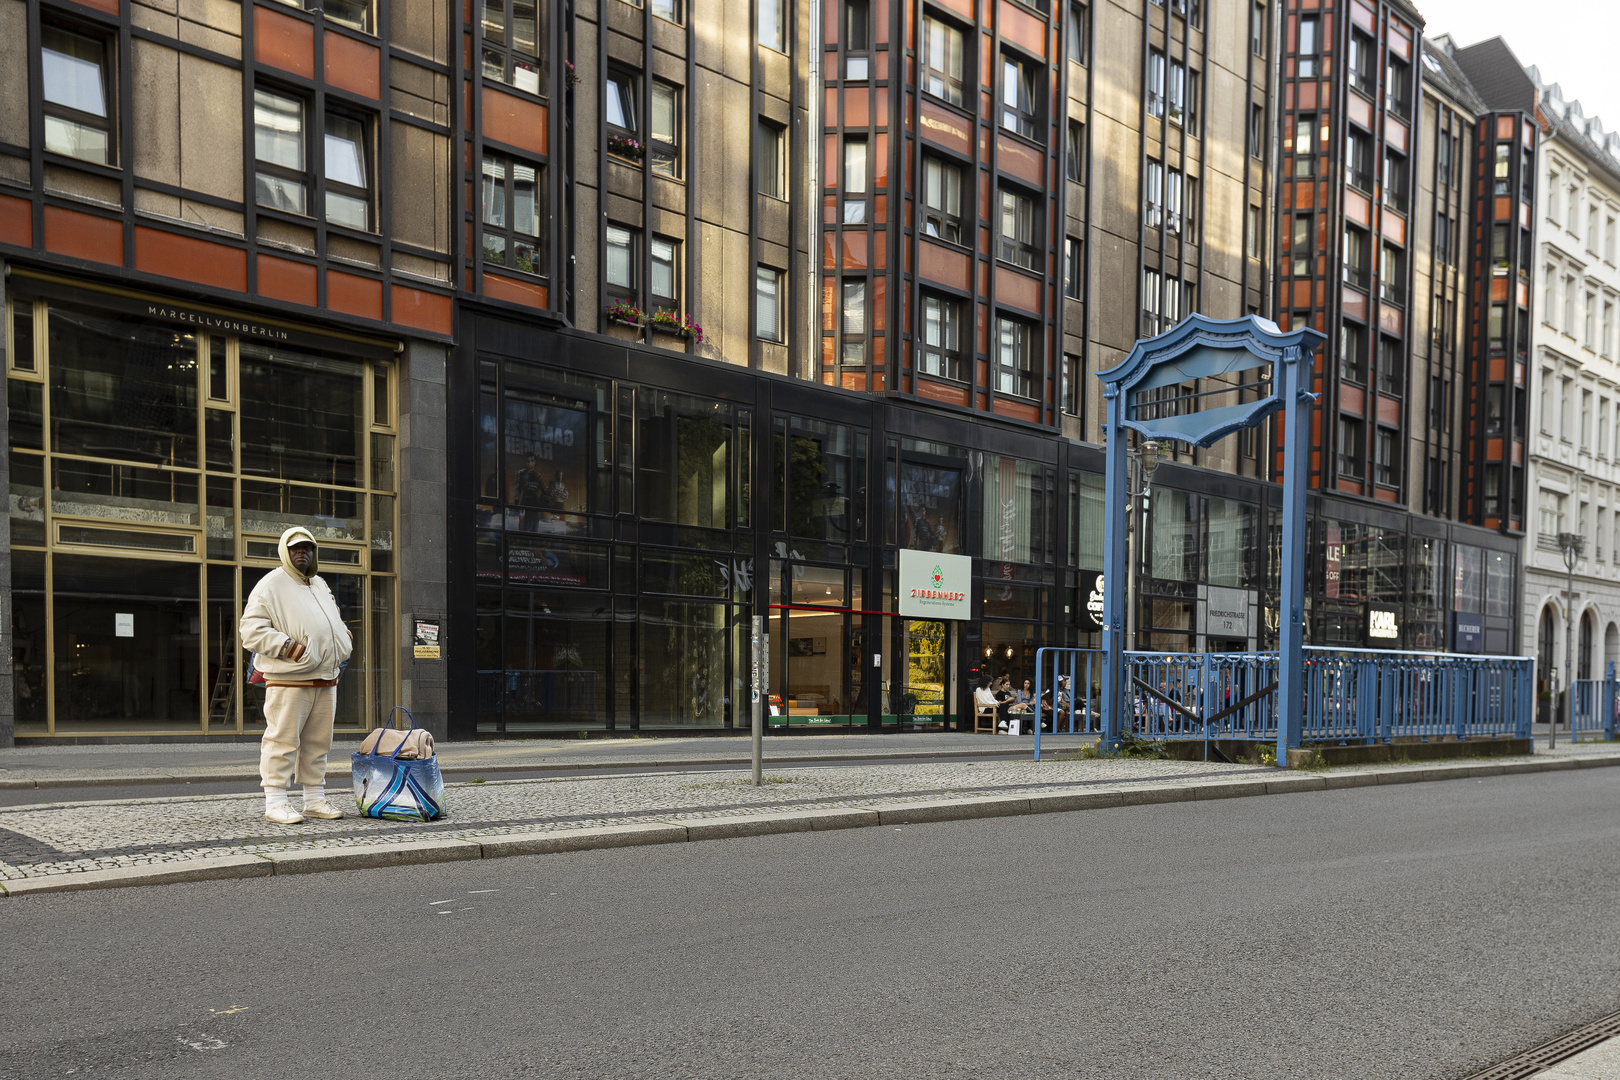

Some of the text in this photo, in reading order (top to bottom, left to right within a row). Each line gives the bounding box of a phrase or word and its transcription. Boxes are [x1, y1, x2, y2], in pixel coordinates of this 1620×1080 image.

[911, 588, 965, 602] ZIRBENHERZ
[1209, 610, 1246, 619] FRIEDRICHSTRASSE
[1369, 610, 1398, 630] KARL
[1223, 620, 1233, 630] 172
